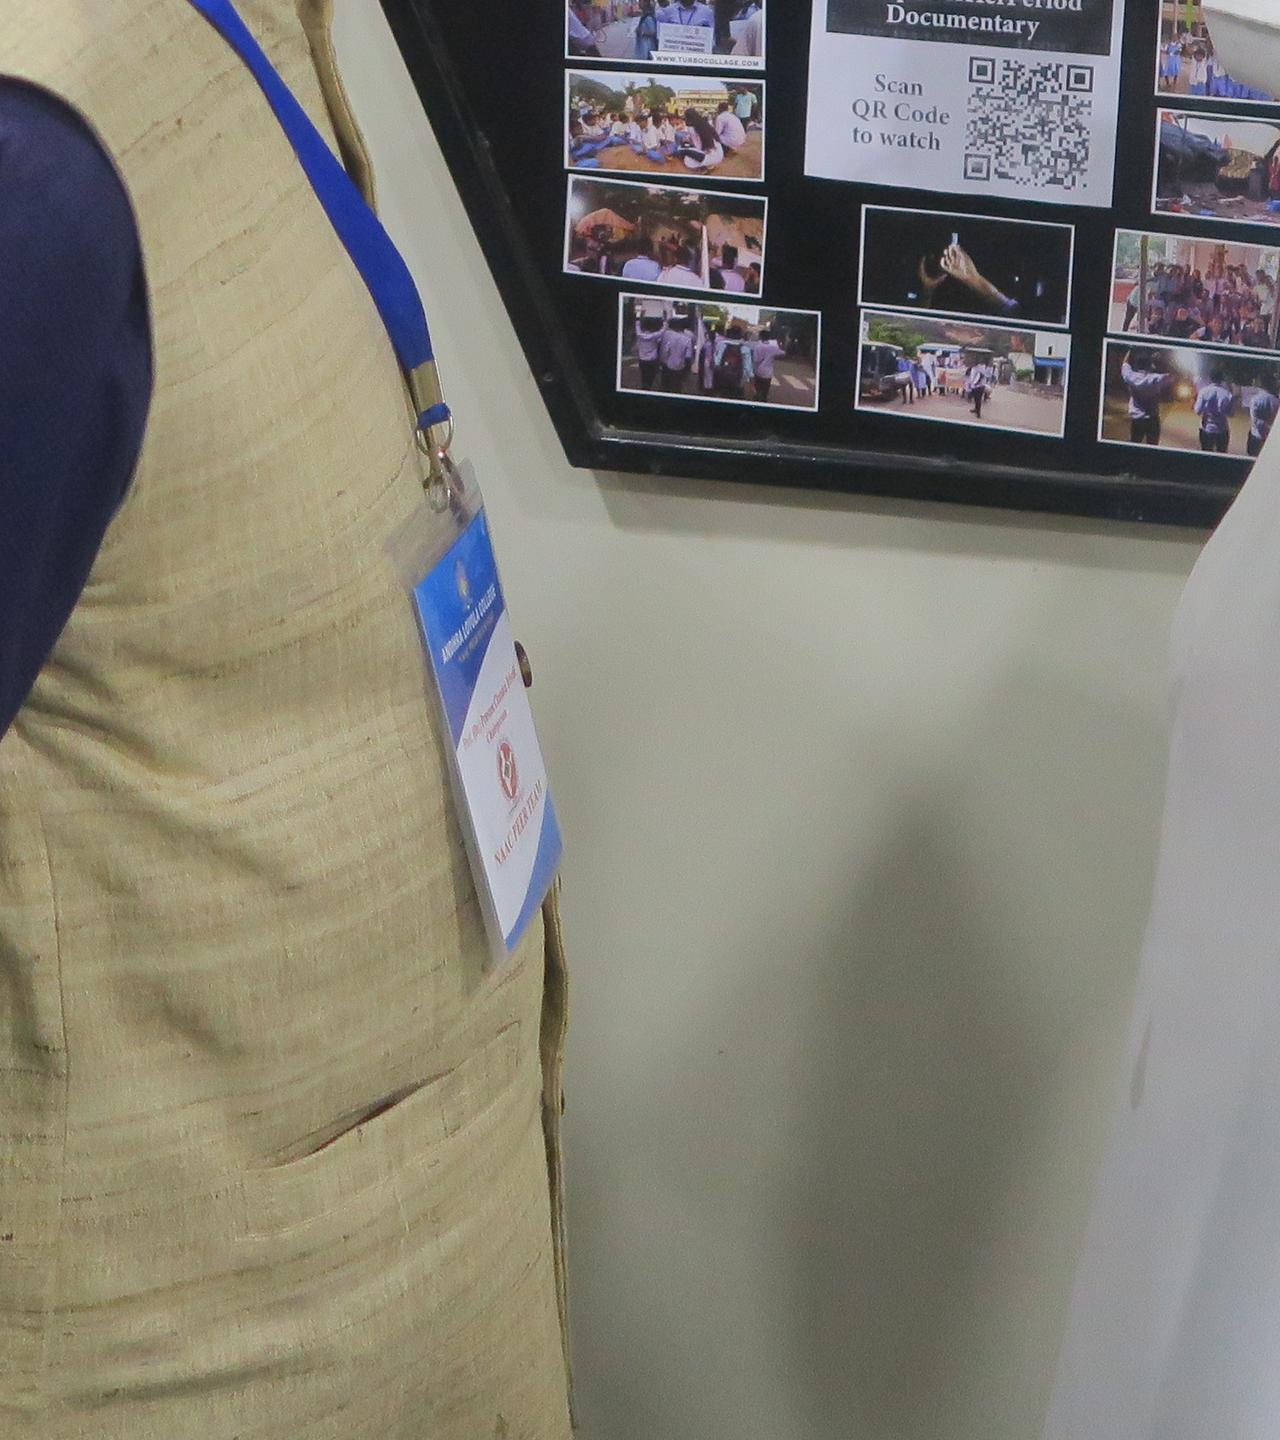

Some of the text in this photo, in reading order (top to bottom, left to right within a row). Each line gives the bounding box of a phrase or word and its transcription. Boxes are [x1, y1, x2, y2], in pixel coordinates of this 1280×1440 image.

[886, 4, 1040, 41] Documentary
[874, 74, 923, 96] Scan
[852, 98, 950, 125] QR Code
[852, 126, 941, 151] to watch
